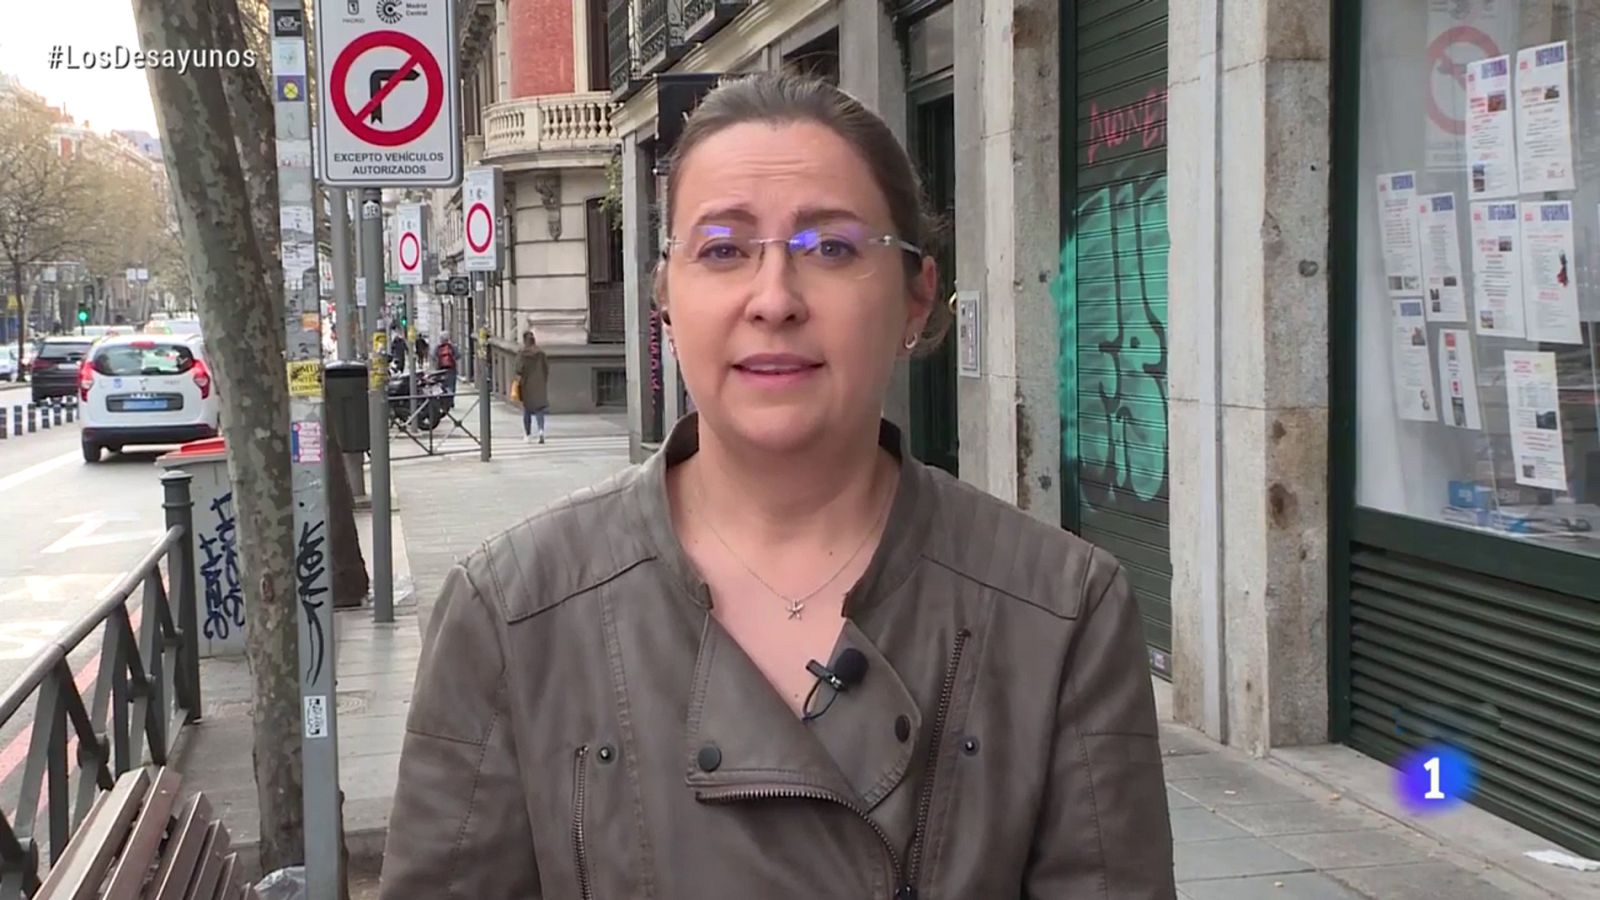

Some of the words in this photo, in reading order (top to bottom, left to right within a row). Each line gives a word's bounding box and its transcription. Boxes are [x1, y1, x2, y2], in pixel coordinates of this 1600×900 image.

[334, 152, 382, 162] EXCEPTO
[384, 151, 444, 161] VEHÍCULOS
[352, 165, 427, 175] AUTORIZADOS
